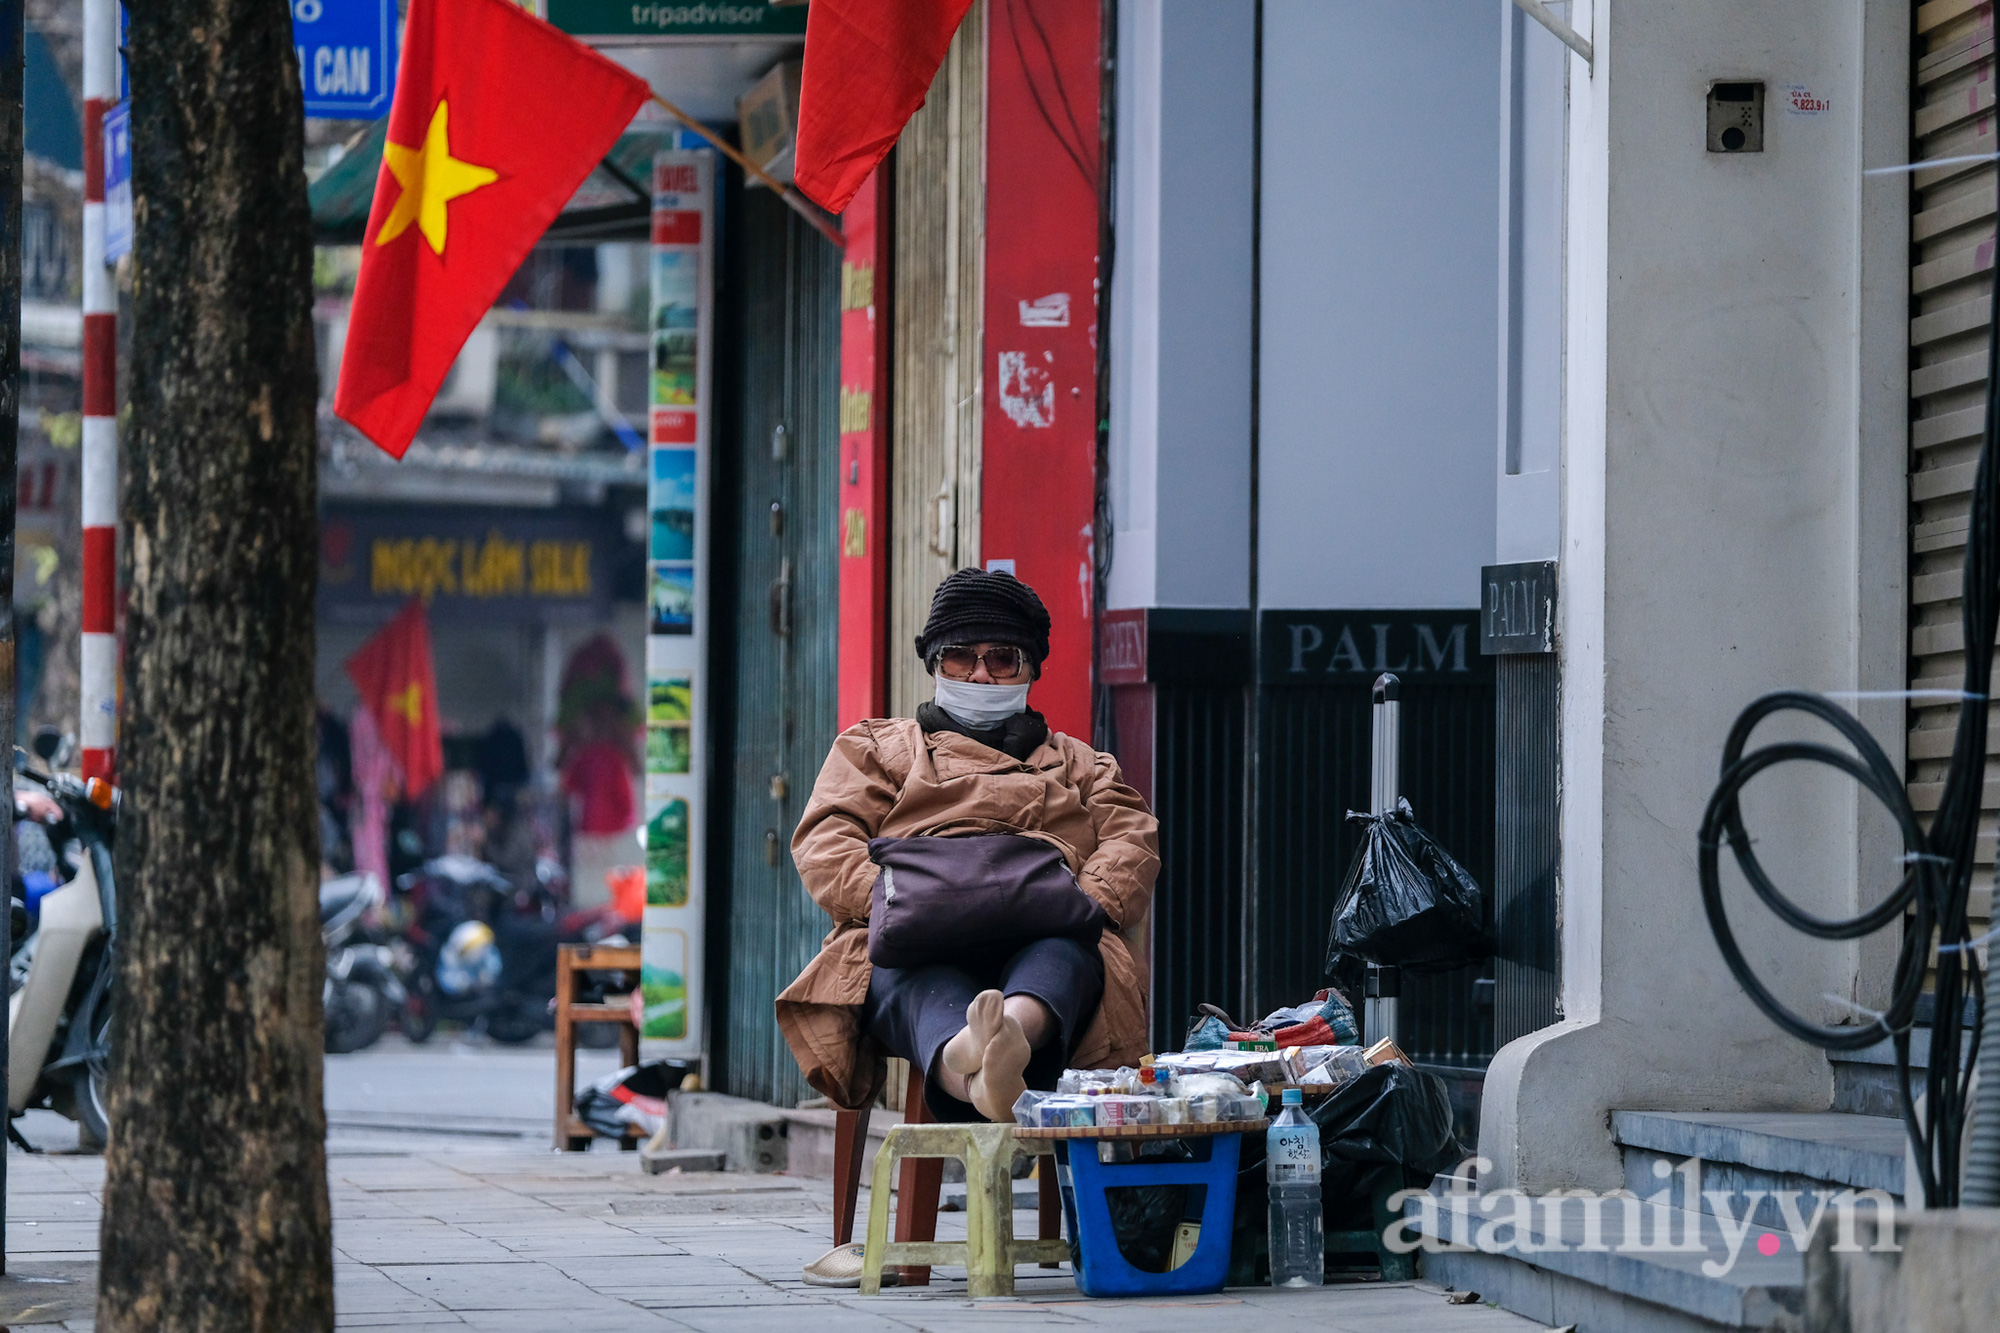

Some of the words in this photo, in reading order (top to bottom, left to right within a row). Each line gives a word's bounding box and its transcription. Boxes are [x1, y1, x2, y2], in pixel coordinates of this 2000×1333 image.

[632, 2, 764, 29] tripadvisor
[313, 45, 370, 96] CAN
[1488, 578, 1537, 637] PALM
[1287, 623, 1470, 673] PALM
[1279, 1134, 1304, 1149] 아침
[1287, 1149, 1310, 1160] 햇살
